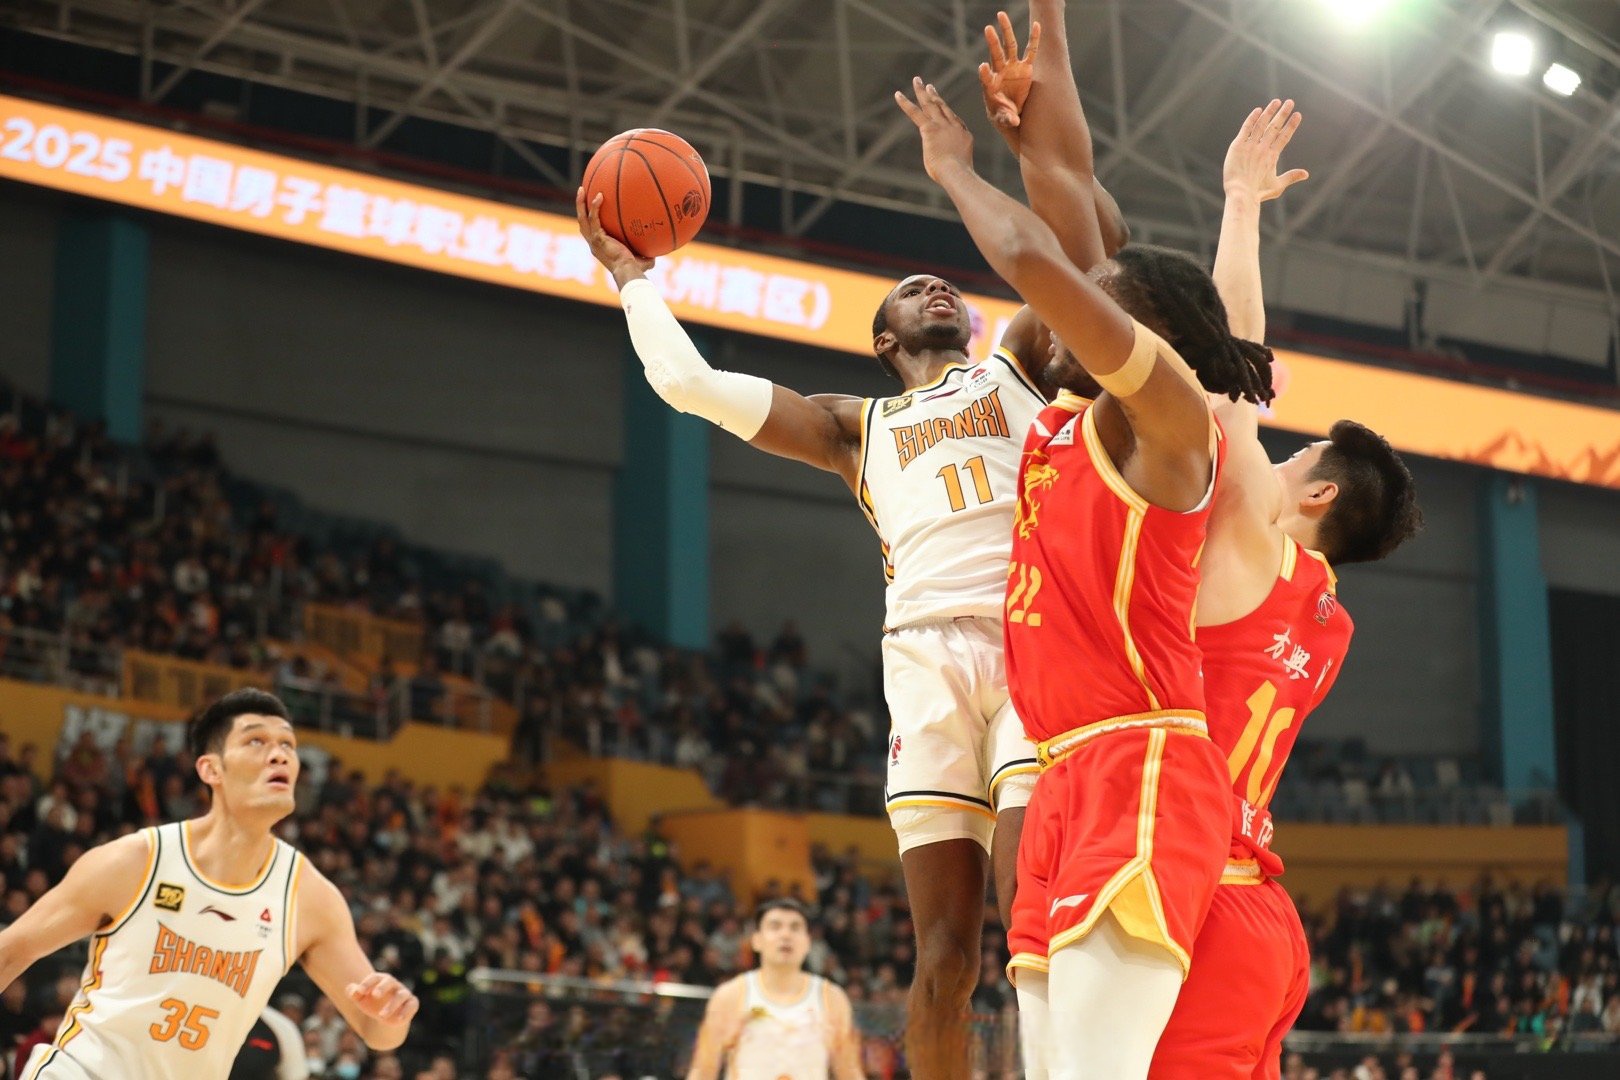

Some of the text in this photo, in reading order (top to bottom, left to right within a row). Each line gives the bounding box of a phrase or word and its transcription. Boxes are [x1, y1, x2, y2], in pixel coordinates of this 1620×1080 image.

[889, 386, 1010, 472] SHANXI
[935, 455, 994, 513] 11
[1007, 561, 1042, 627] 22
[149, 920, 264, 998] SHANXI
[150, 998, 220, 1051] 35
